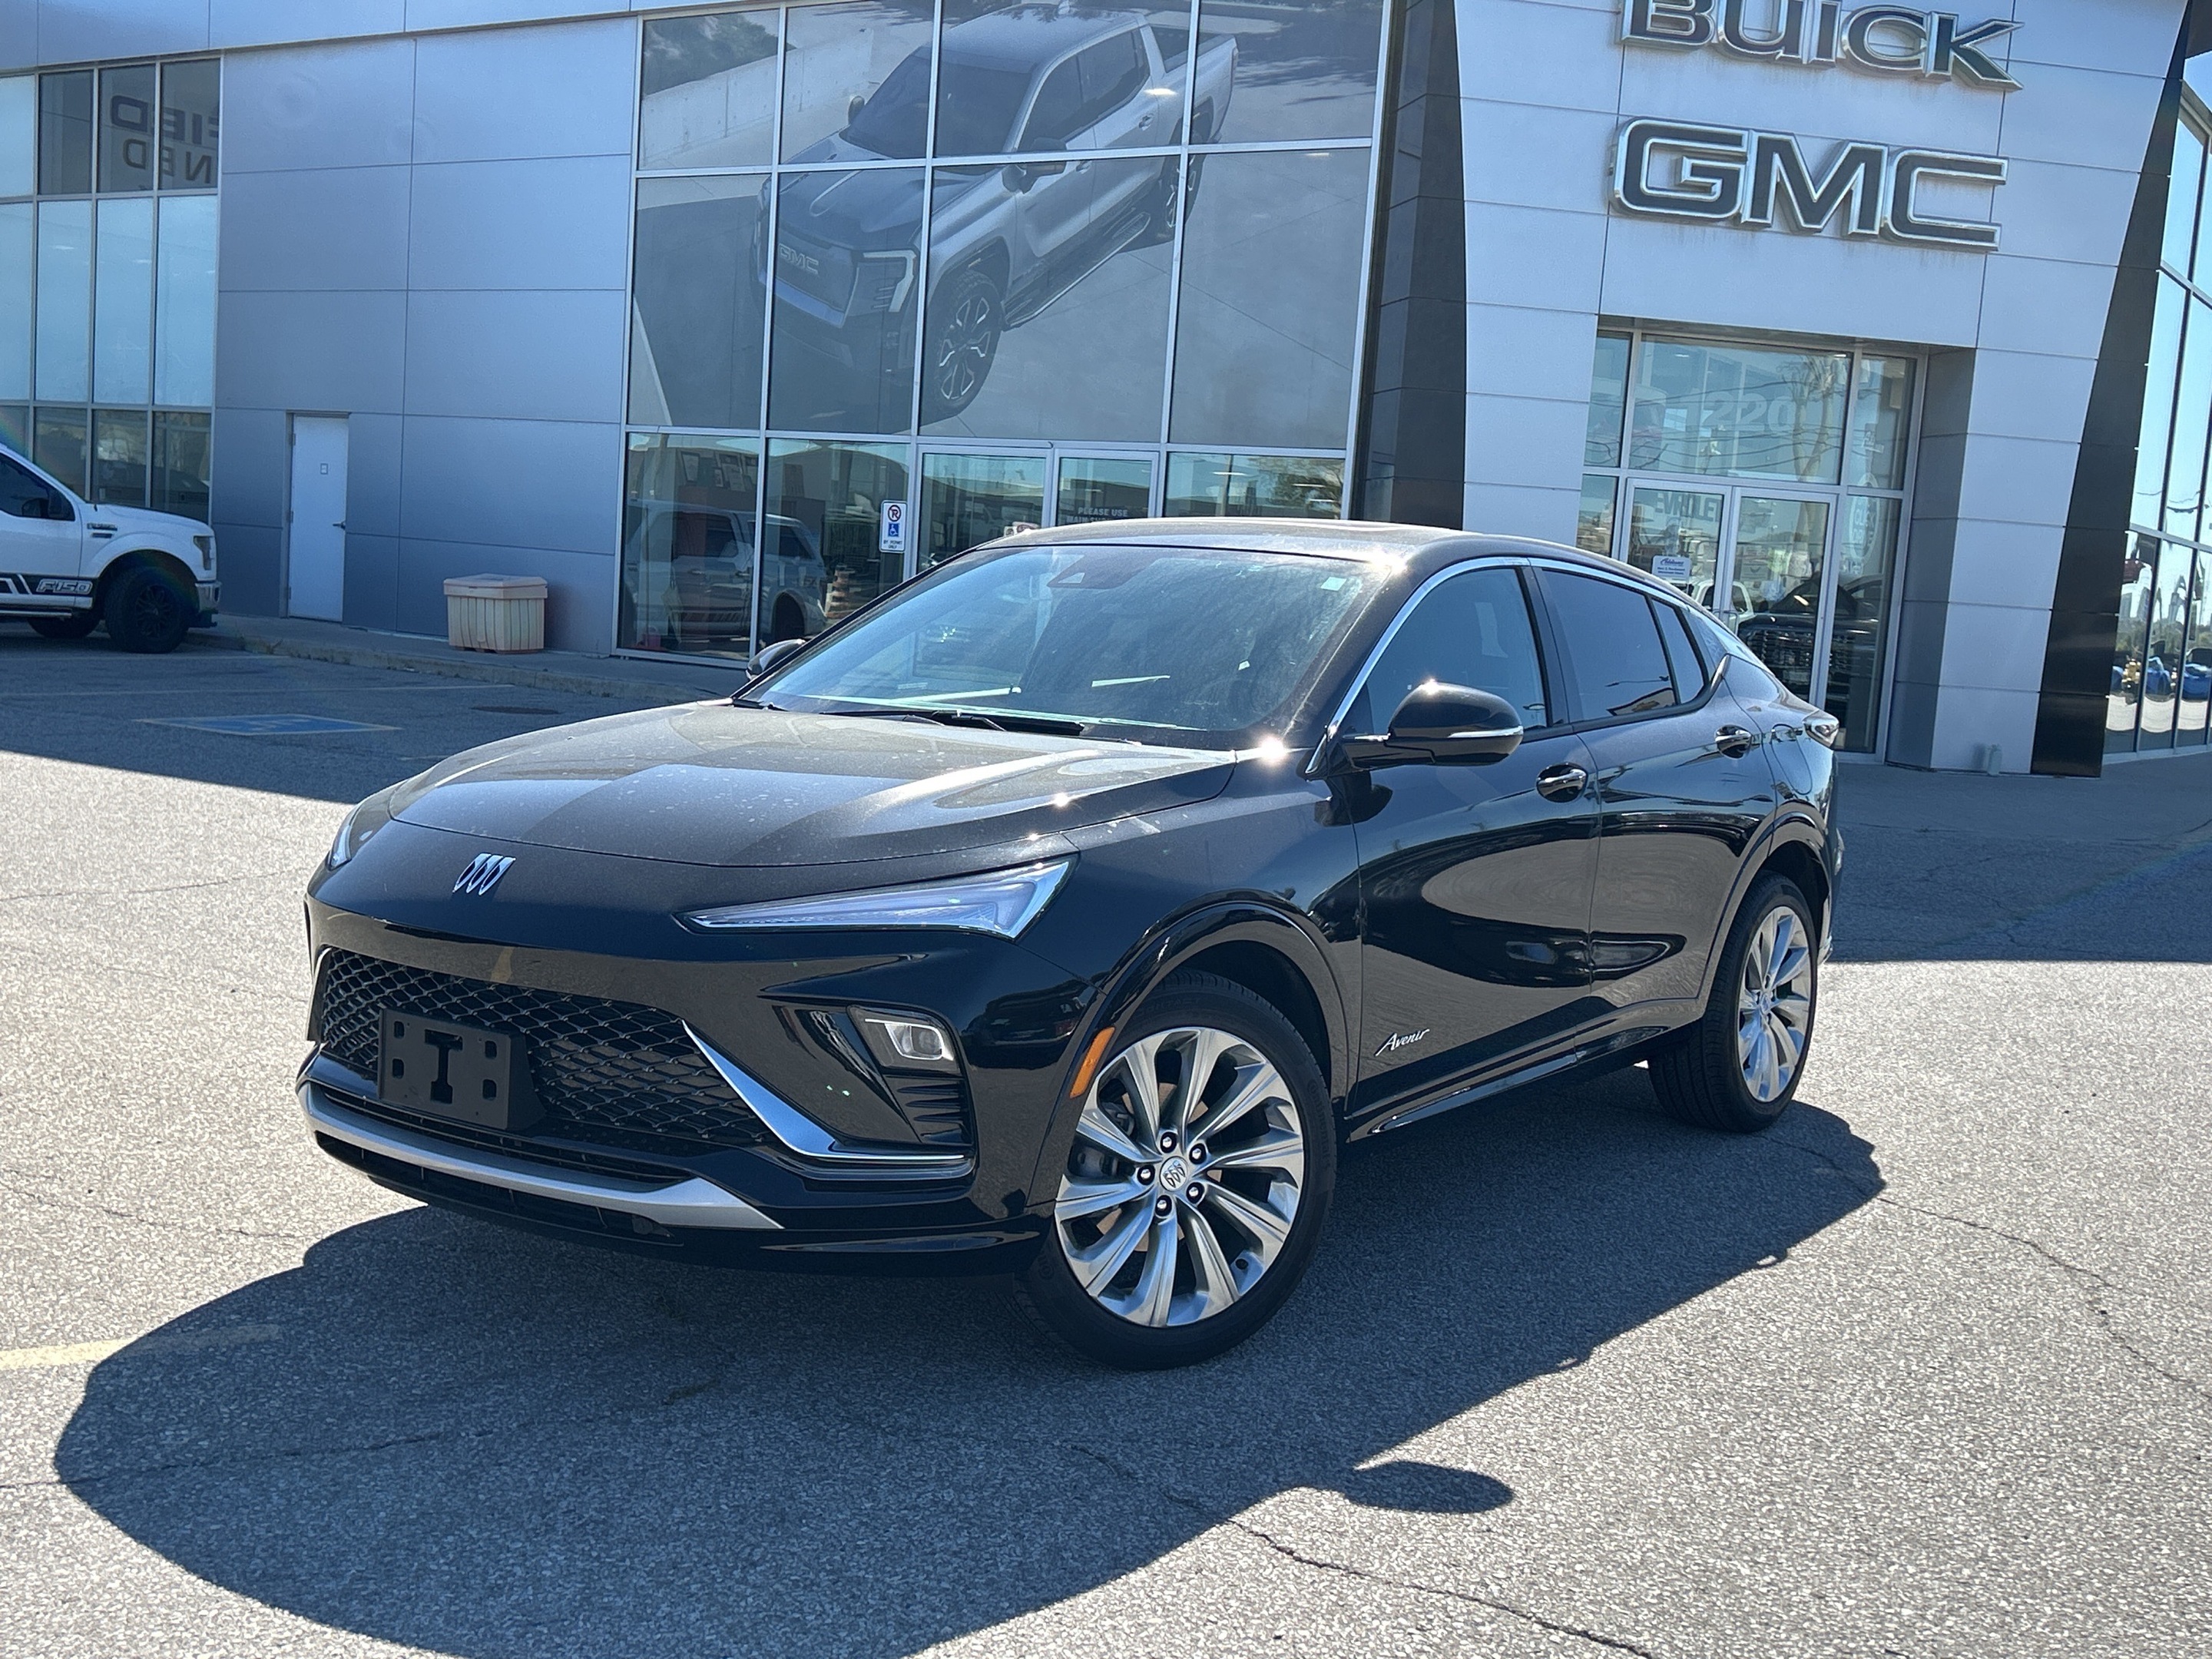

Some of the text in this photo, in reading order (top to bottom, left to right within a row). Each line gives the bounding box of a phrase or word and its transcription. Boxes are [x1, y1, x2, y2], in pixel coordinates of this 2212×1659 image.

[1620, 0, 2025, 92] BUICK
[1612, 116, 2009, 252] GMC
[778, 243, 820, 275] GMC
[1078, 506, 1110, 516] PLEASE
[1374, 1028, 1430, 1057] Avenir
